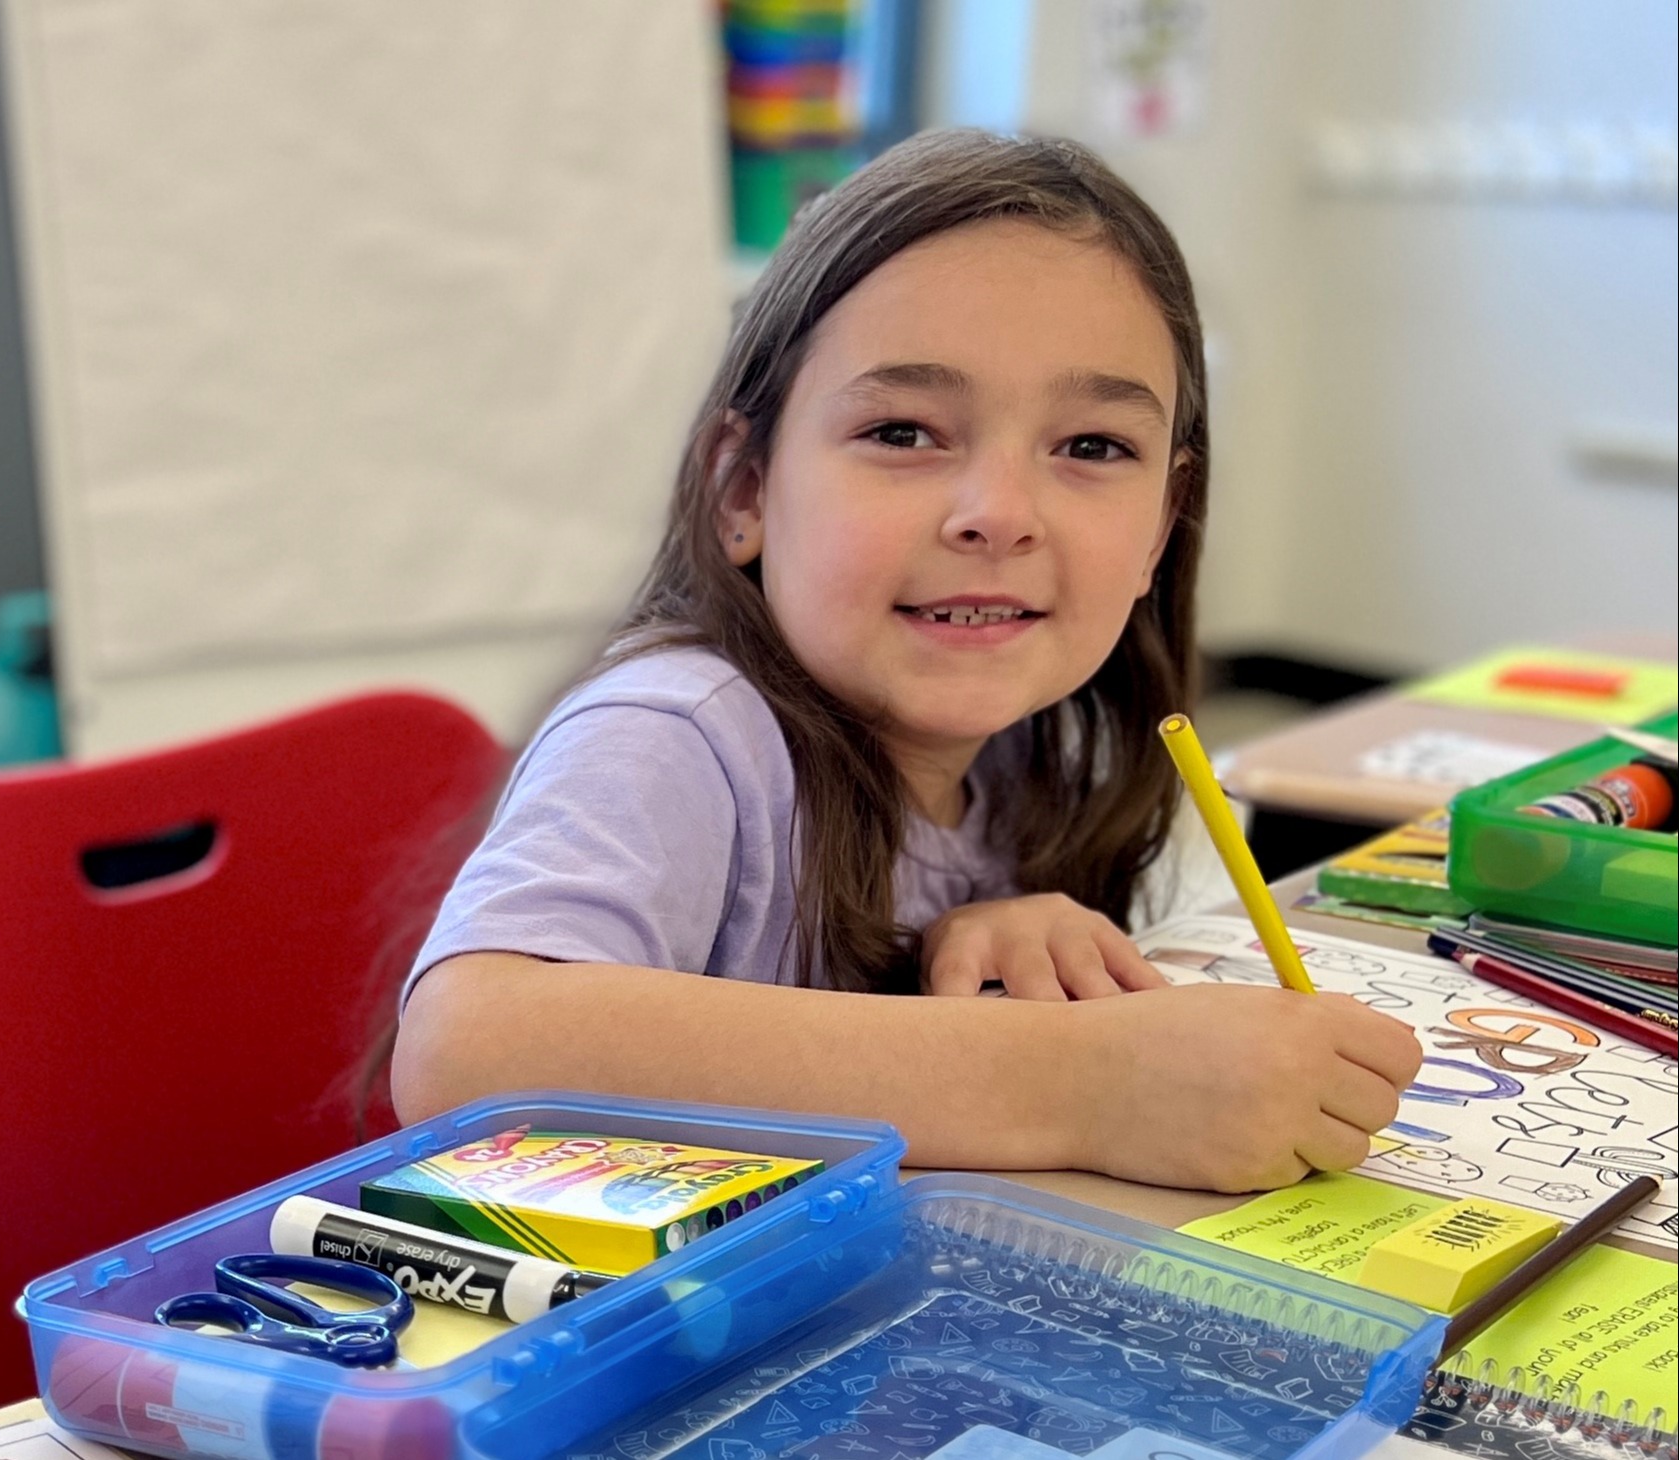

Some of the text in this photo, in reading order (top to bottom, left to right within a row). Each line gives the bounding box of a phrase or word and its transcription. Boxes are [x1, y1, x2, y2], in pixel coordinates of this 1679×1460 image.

[1386, 1007, 1602, 1143] GRO
[455, 1139, 608, 1188] CRAYONS
[463, 1147, 505, 1162] 24
[638, 1163, 775, 1210] Crayola
[1278, 1198, 1326, 1215] Love,
[320, 1239, 353, 1259] chisel
[395, 1242, 462, 1272] dry erase
[393, 1264, 497, 1315] EXPO
[1559, 1303, 1600, 1325] fear!
[1586, 1306, 1645, 1335] ERASE
[1525, 1347, 1562, 1377] your
[1577, 1351, 1608, 1372] and
